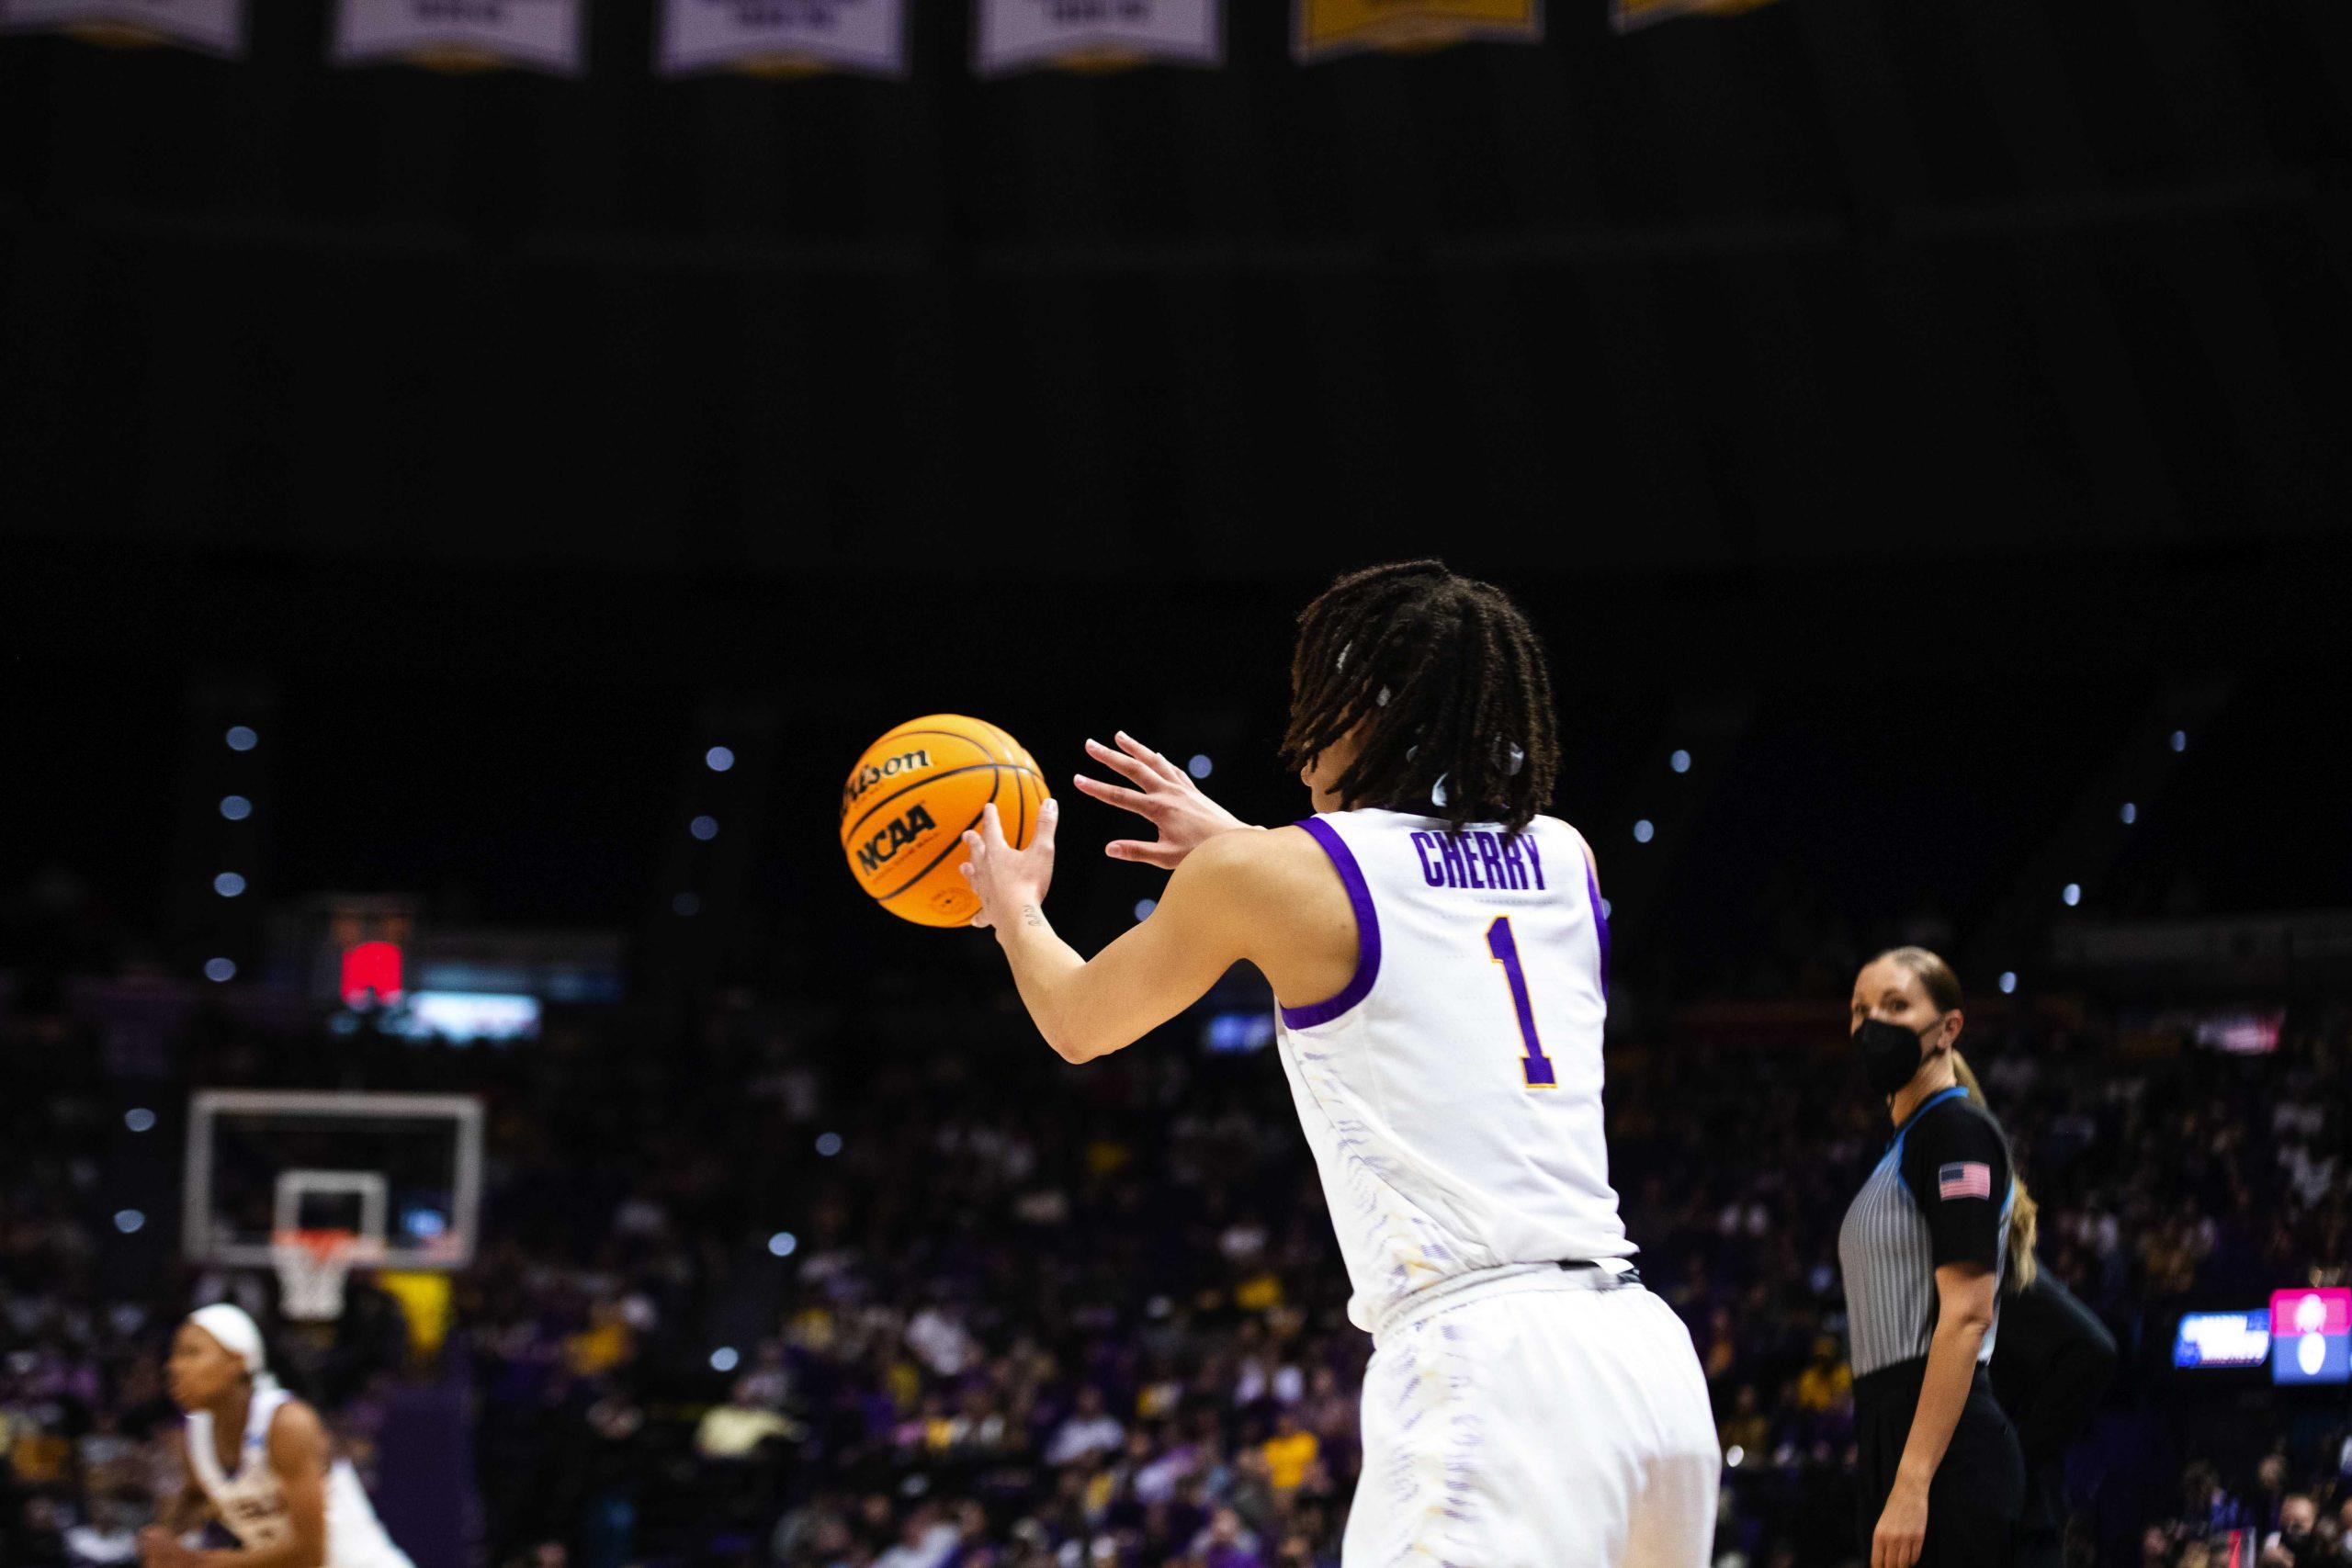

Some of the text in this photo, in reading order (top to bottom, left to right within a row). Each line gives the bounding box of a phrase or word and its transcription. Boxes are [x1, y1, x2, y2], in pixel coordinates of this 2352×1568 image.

[856, 804, 936, 876] NCAA
[1409, 830, 1546, 890] CHERRY
[1484, 915, 1558, 1089] 1
